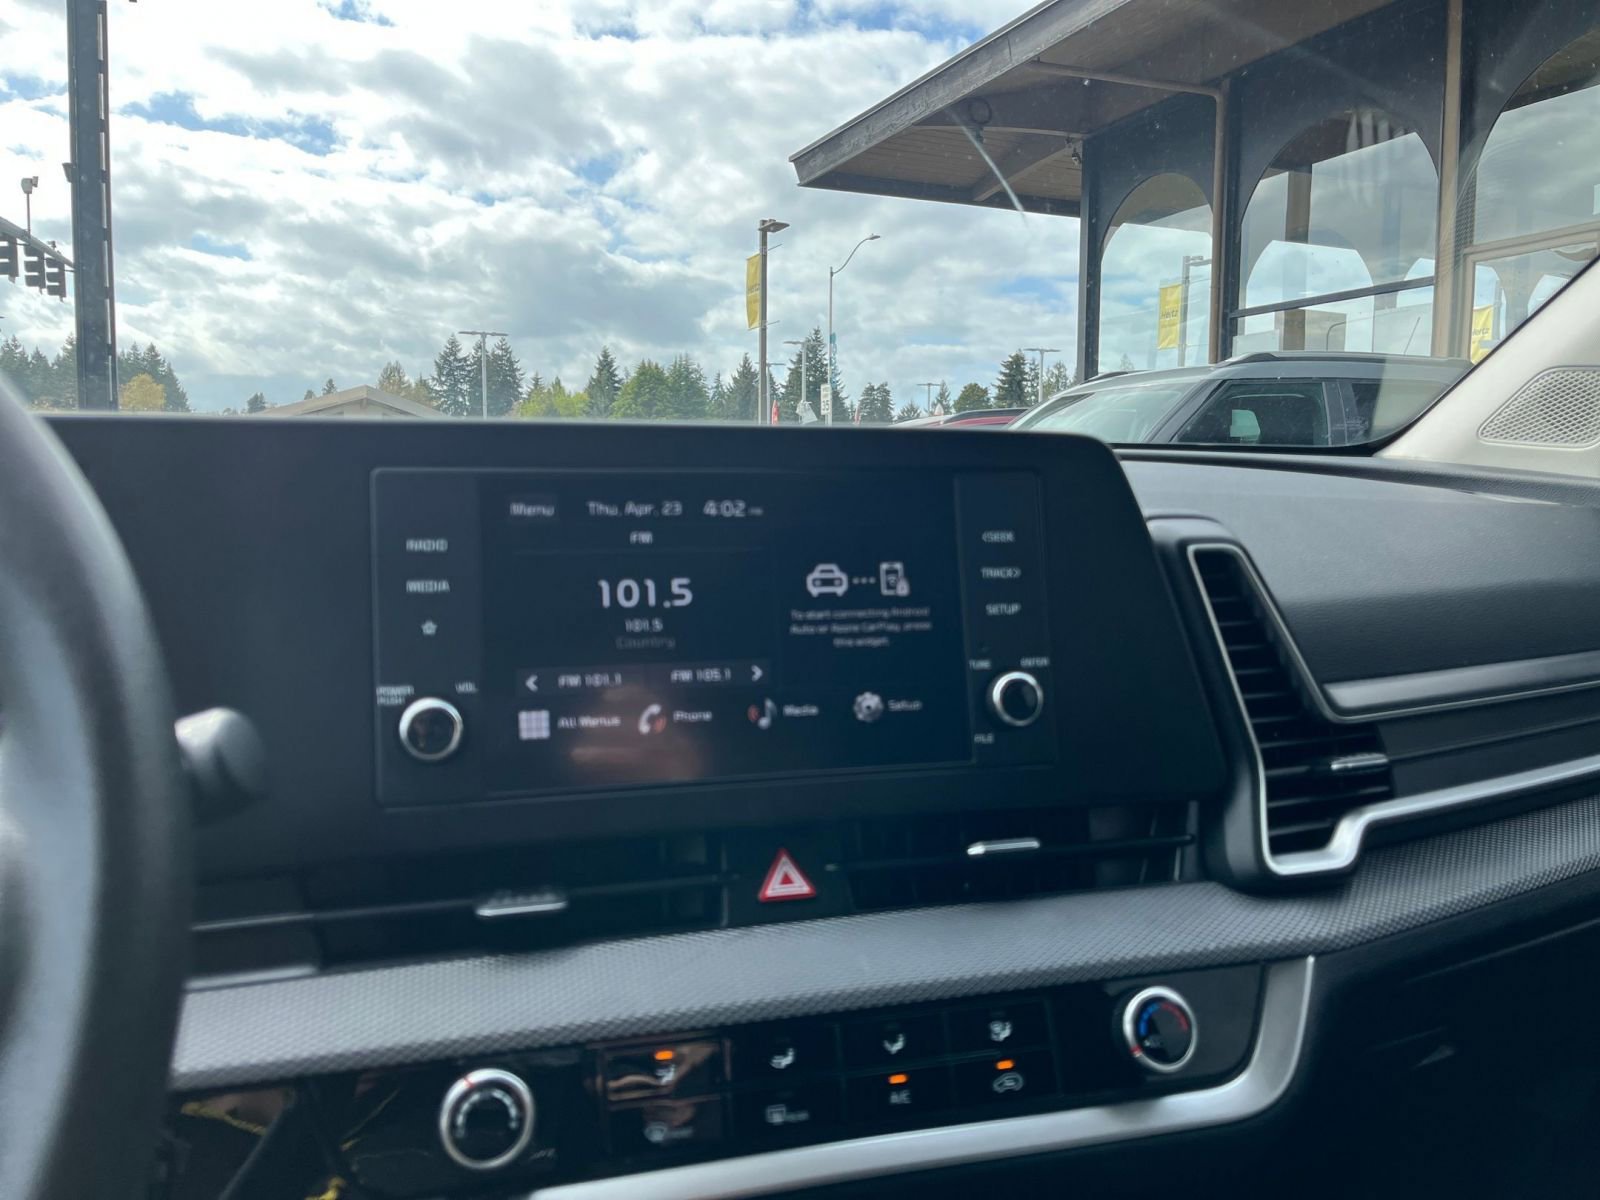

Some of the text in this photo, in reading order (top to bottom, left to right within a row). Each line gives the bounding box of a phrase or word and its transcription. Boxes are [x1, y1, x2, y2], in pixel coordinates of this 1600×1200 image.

[510, 502, 555, 516] Menu
[661, 501, 683, 516] 23
[703, 499, 745, 517] 4:02
[630, 531, 653, 544] FM
[406, 538, 448, 552] RADIO
[406, 580, 450, 593] MEDIA
[597, 576, 694, 609] 101.5
[985, 603, 1021, 616] SETUP
[624, 619, 663, 633] 101.5
[1020, 656, 1049, 668] ENTER
[558, 675, 581, 688] FM
[671, 669, 693, 682] FM
[455, 682, 478, 694] VOL
[783, 703, 819, 717] Media
[888, 699, 923, 713] Setup
[558, 714, 621, 729] All Menus
[673, 709, 713, 723] Phone
